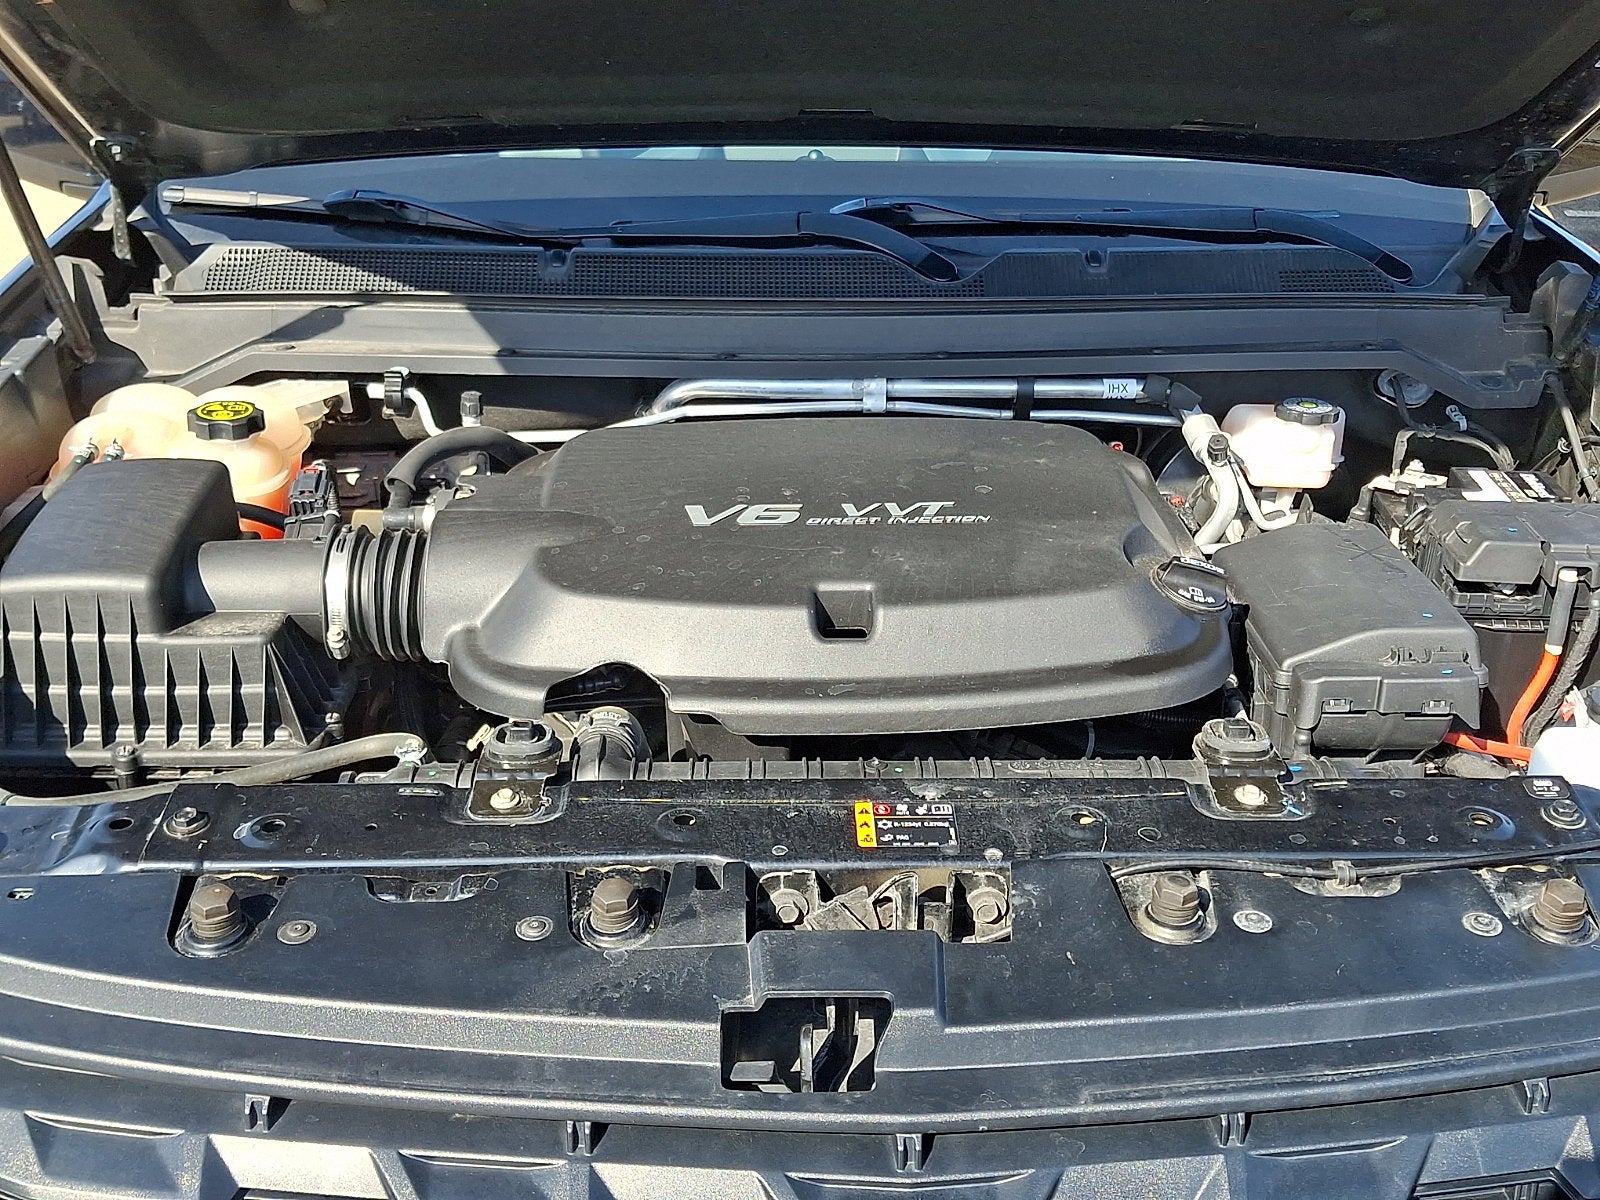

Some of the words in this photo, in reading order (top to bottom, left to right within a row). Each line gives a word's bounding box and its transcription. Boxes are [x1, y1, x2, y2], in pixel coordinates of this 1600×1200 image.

[1108, 383, 1129, 394] IHX
[684, 503, 804, 527] V6
[841, 501, 956, 516] VVT
[805, 515, 882, 526] DIRECT
[887, 515, 993, 525] INJECTION
